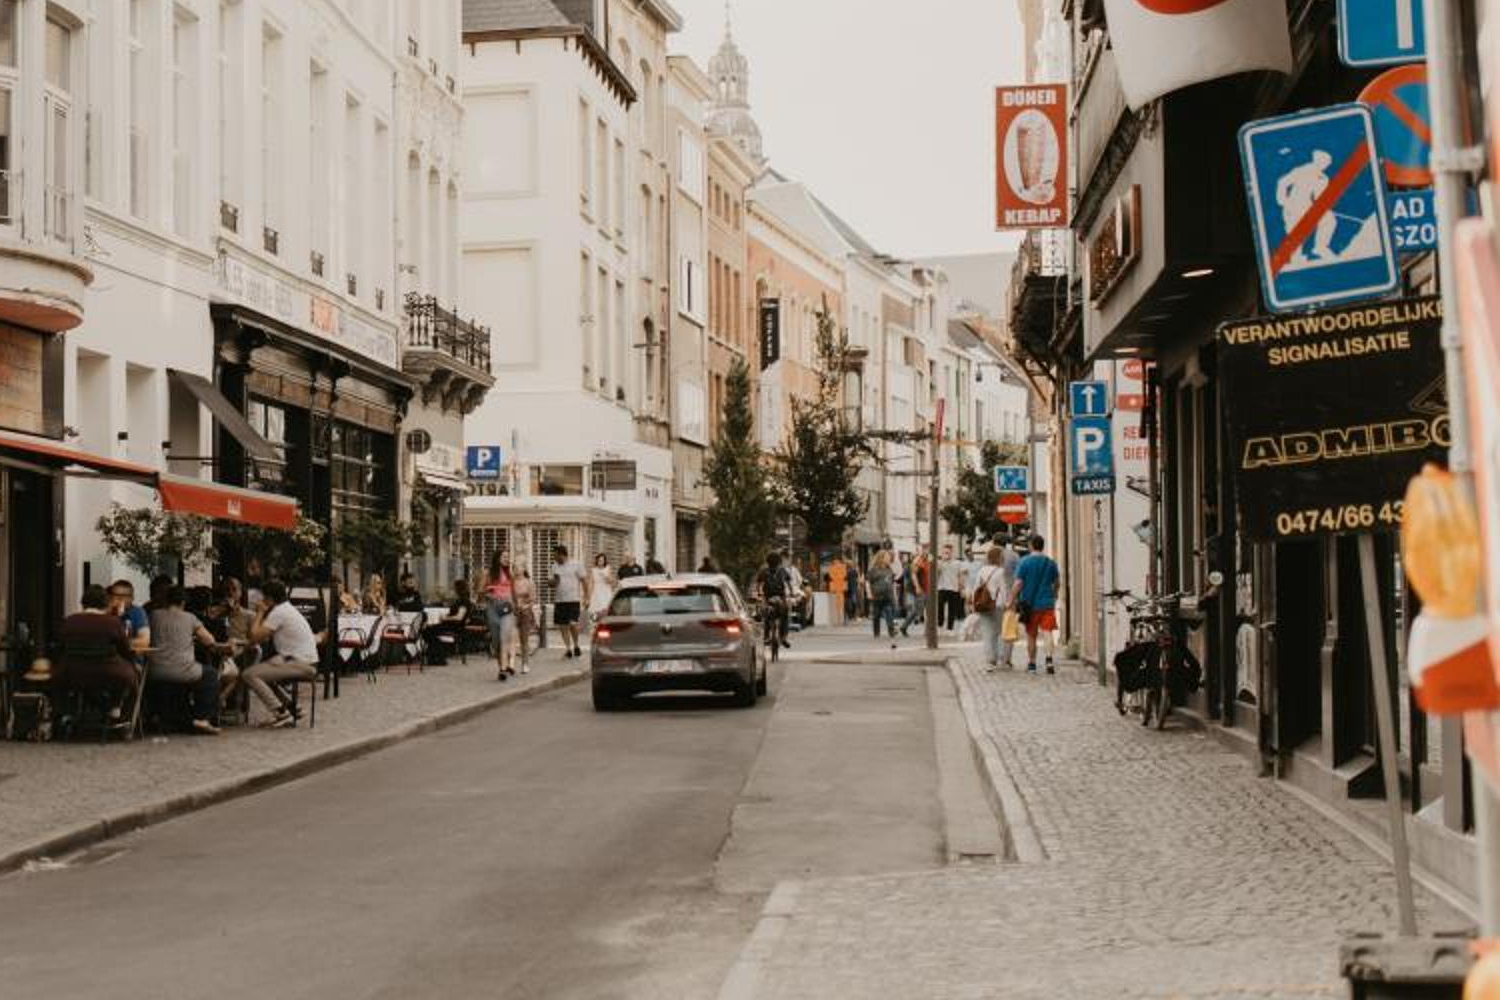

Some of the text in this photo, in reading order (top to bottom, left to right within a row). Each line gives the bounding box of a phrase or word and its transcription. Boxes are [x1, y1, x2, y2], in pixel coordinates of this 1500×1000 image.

[1268, 331, 1411, 366] SIGNALISATIE
[1076, 479, 1111, 491] TAXIS
[1277, 504, 1375, 535] 0474/66
